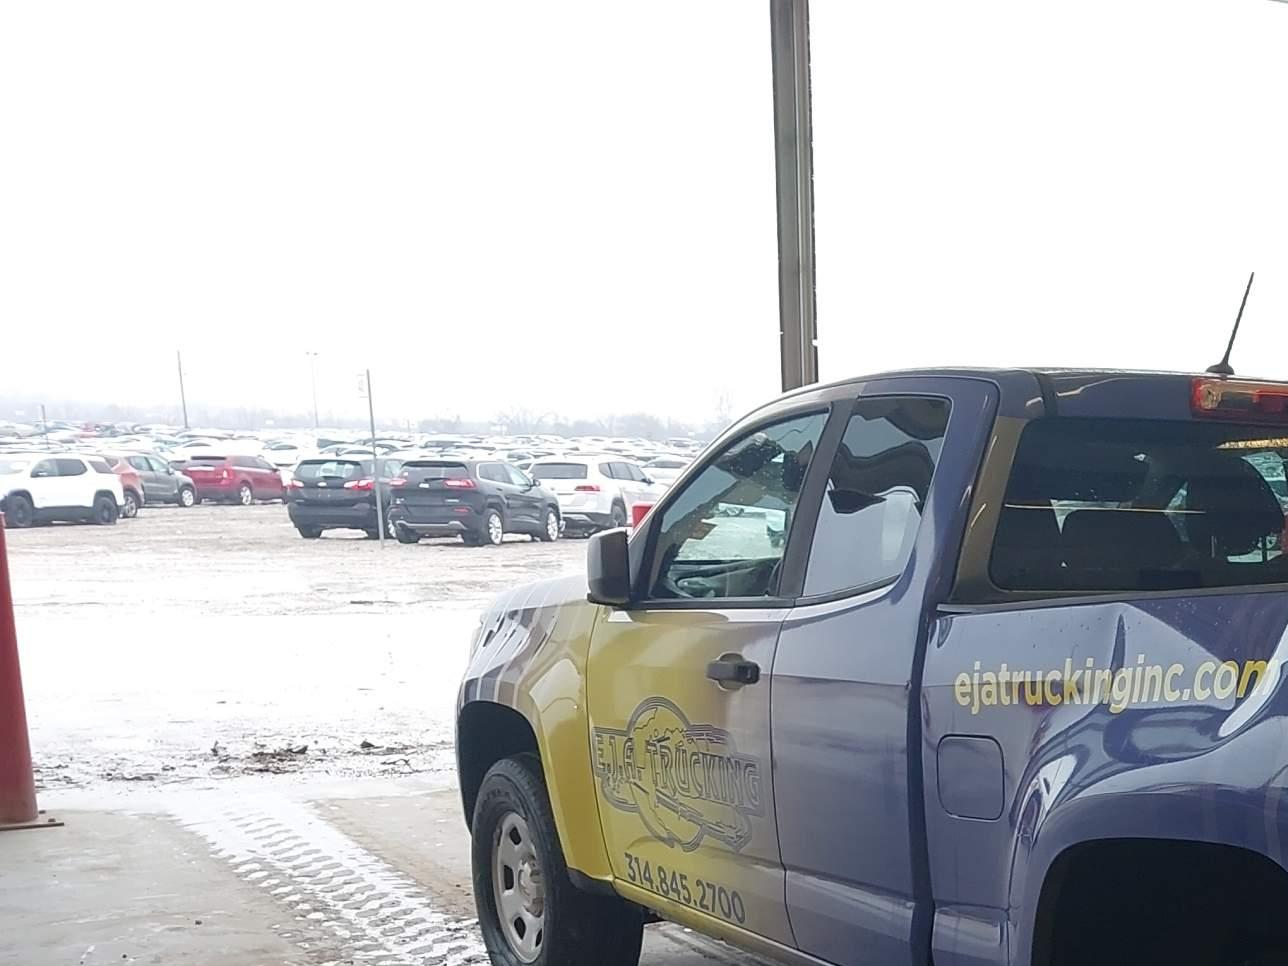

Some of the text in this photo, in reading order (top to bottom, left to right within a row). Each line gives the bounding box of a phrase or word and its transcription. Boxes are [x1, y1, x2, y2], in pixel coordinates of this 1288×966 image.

[954, 654, 1279, 714] ejatruckinginc.com
[645, 739, 761, 807] TRUCKING
[624, 851, 746, 924] 314.845.2700
